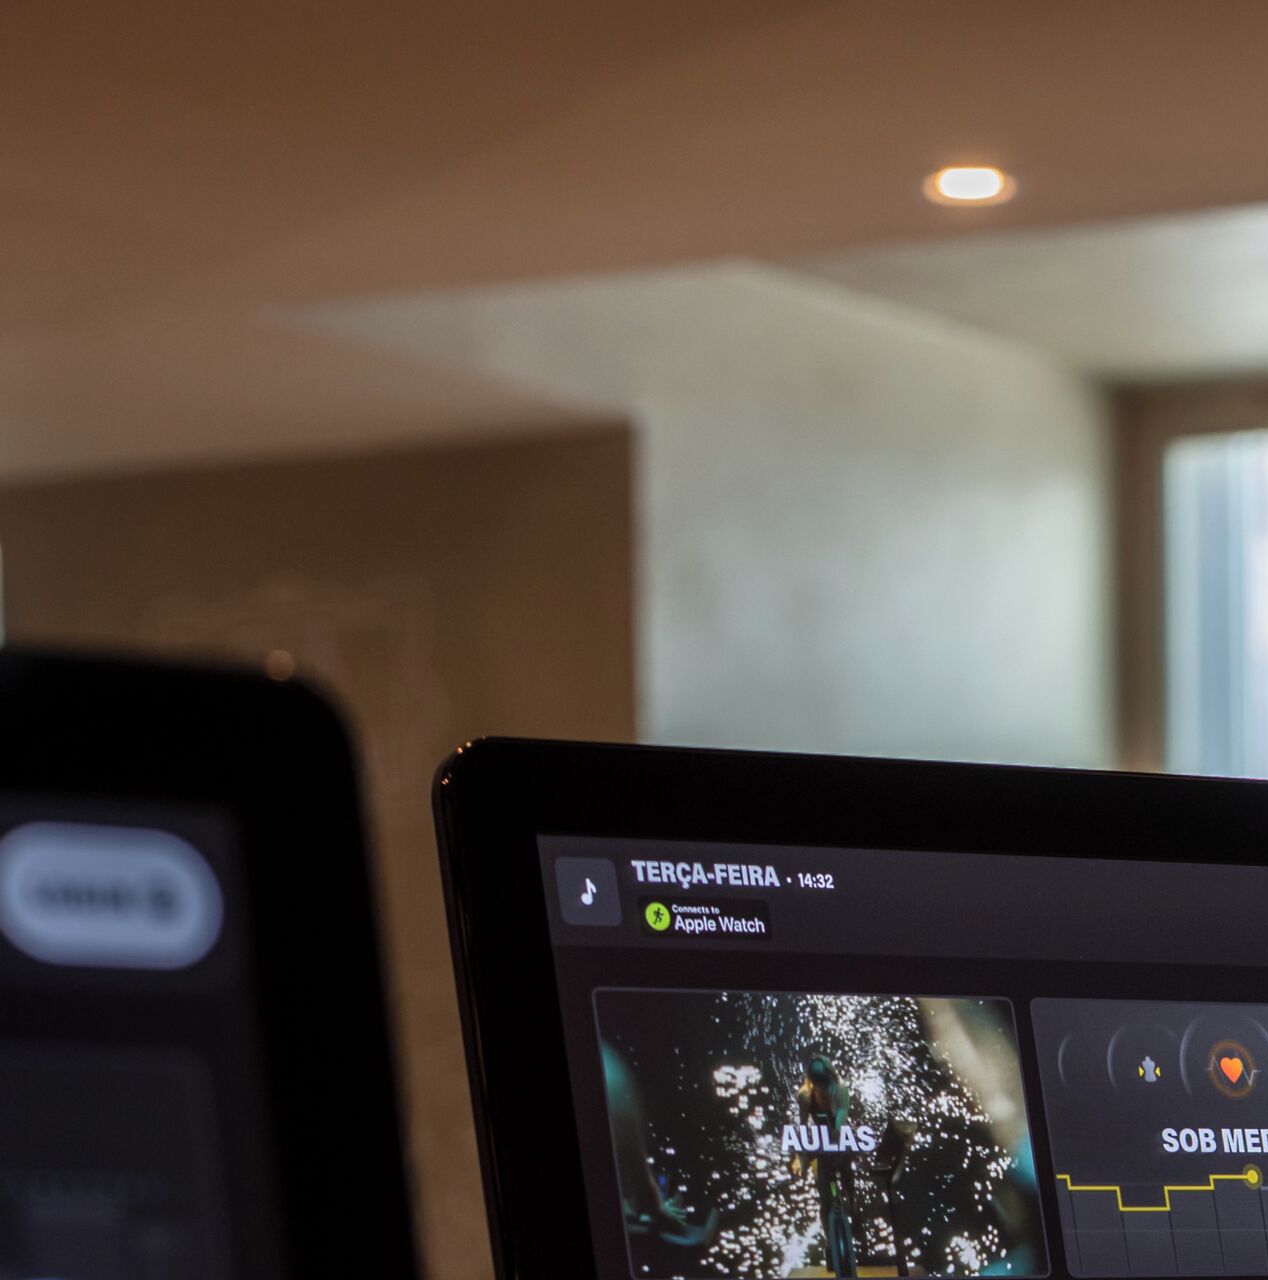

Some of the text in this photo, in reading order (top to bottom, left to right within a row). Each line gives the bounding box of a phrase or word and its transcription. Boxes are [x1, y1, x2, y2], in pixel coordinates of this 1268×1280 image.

[631, 860, 835, 889] TERÇA-FEIRA 14:32
[671, 904, 720, 914] Connects to
[674, 915, 766, 934] Apple Watch
[781, 1124, 877, 1152] AULAS
[1161, 1127, 1216, 1153] SOB
